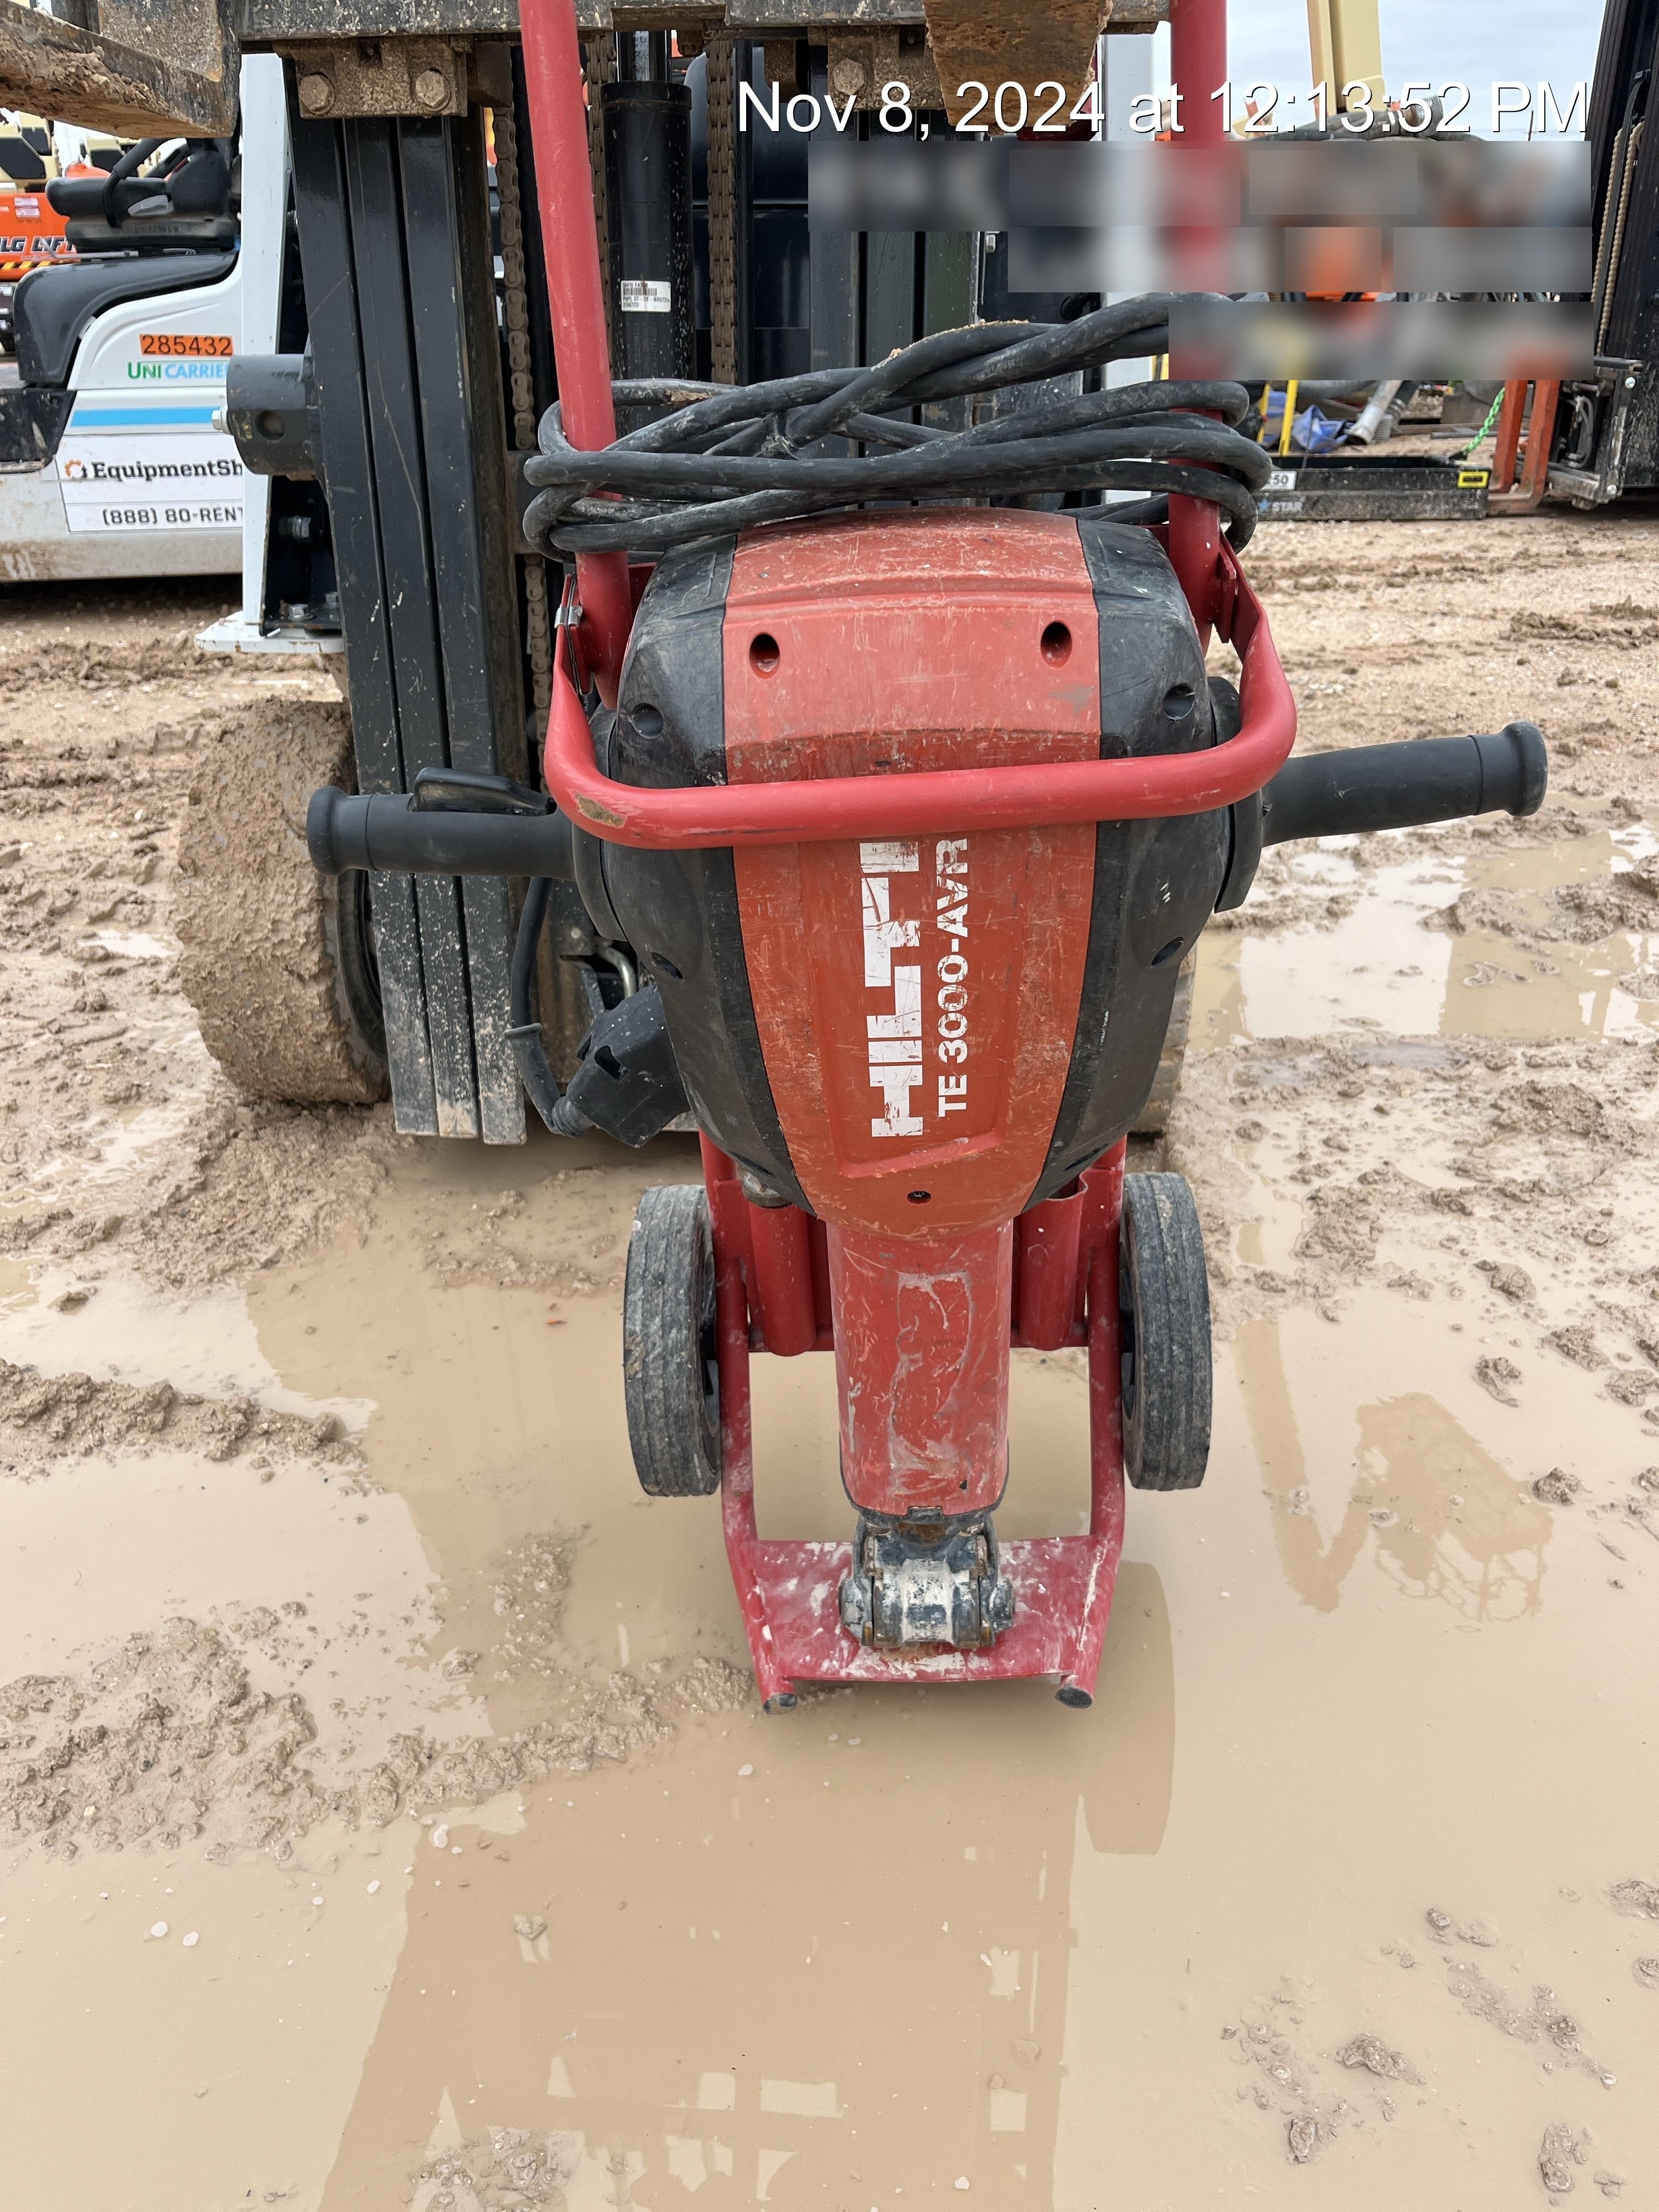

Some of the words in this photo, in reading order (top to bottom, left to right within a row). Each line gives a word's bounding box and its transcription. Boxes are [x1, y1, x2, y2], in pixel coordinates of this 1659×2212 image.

[142, 334, 233, 356] 285432
[103, 507, 157, 526] (888)
[936, 838, 969, 1064] 3000-AVR
[859, 842, 923, 1137] HILTI
[938, 1074, 967, 1118] TE
